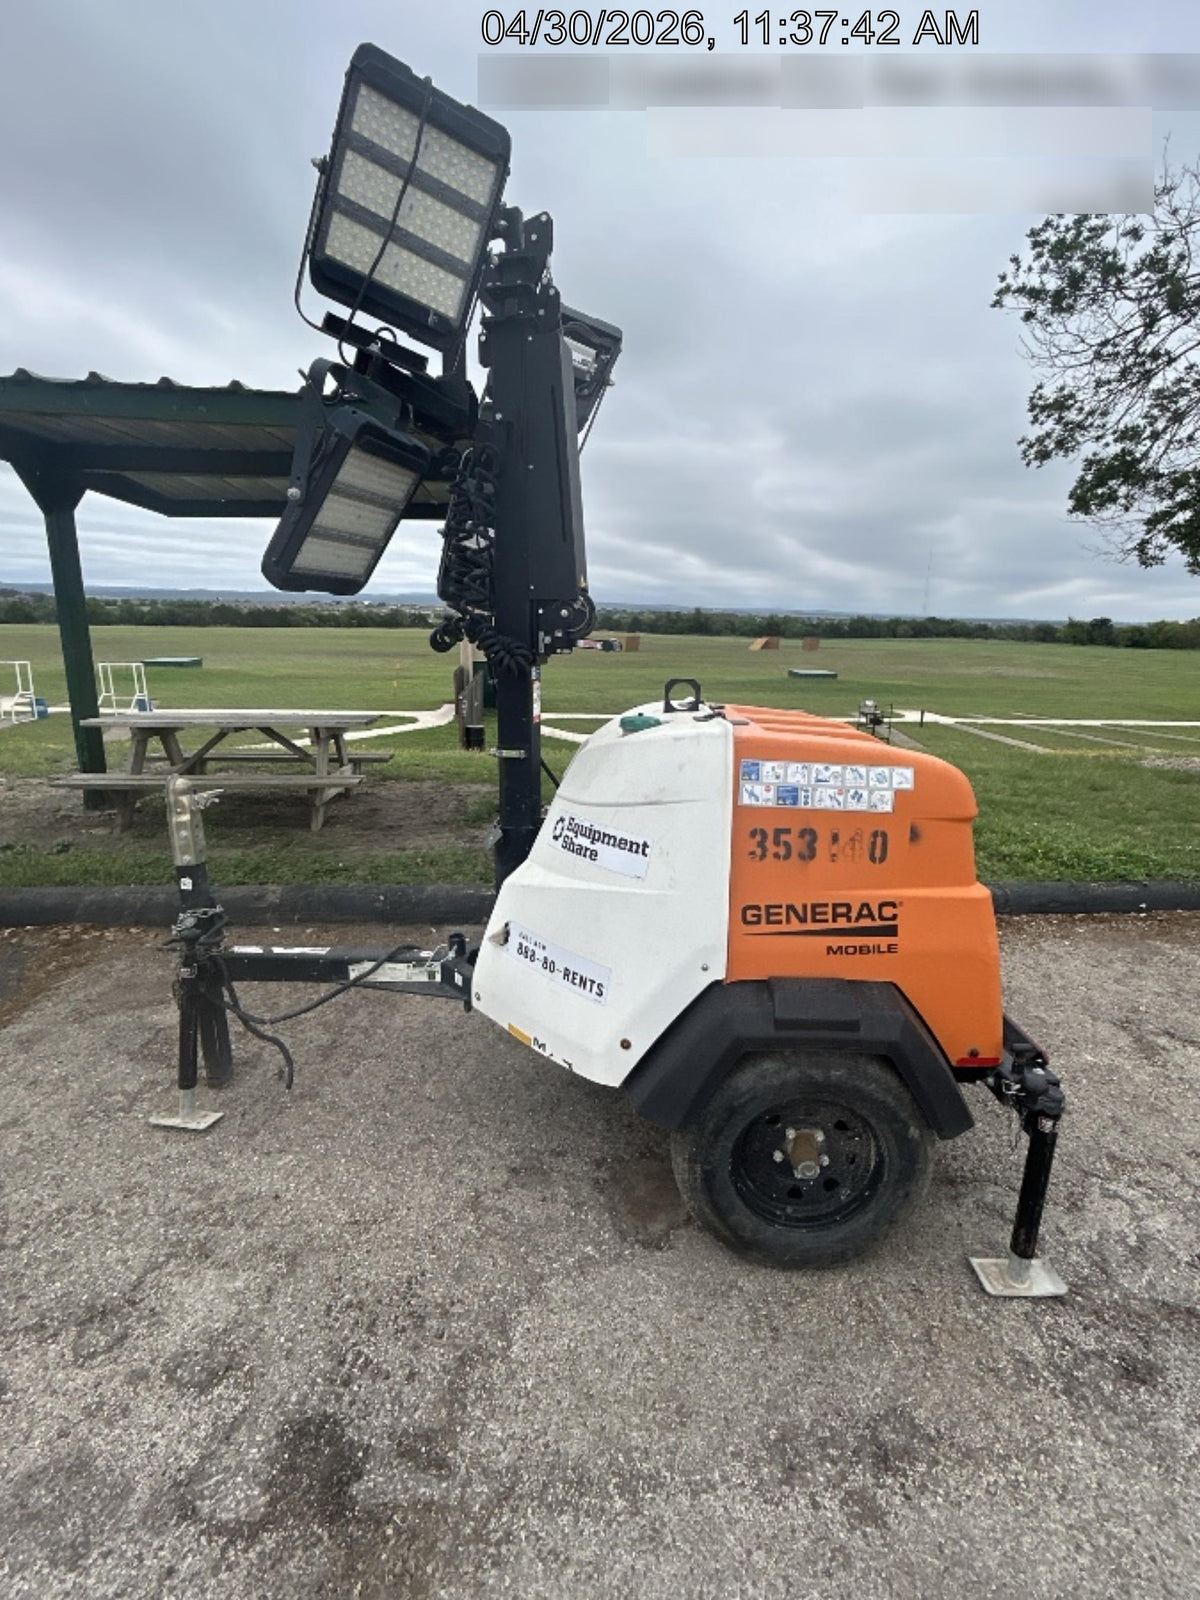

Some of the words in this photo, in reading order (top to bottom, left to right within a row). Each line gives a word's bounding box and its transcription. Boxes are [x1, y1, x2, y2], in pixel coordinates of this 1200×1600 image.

[561, 835, 599, 862] Share
[566, 816, 650, 857] Equipment
[741, 901, 899, 926] GENERAC
[826, 943, 899, 956] MOBILE
[516, 942, 605, 998] 888-80-RENTS
